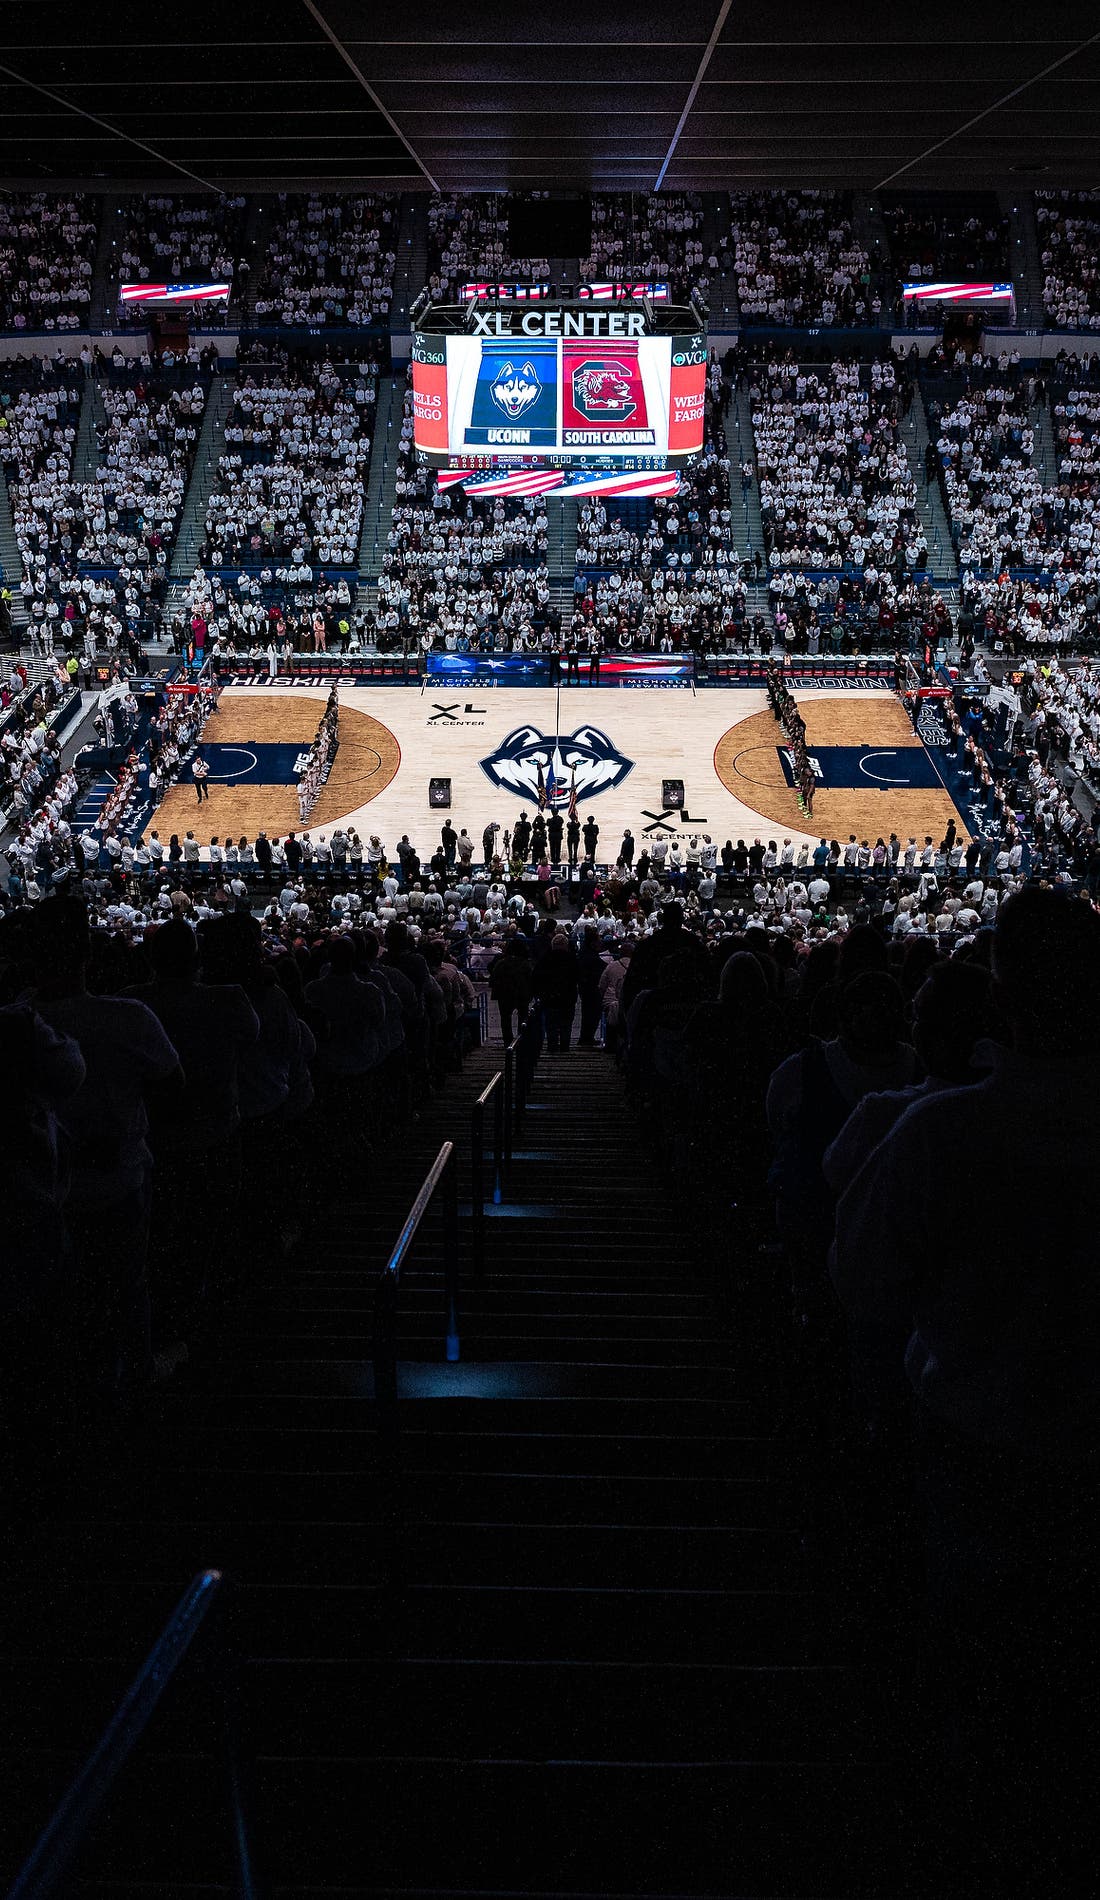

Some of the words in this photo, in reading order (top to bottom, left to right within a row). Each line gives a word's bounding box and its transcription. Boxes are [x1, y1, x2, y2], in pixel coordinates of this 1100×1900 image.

[472, 312, 512, 336] XL
[522, 312, 646, 336] CENTER
[415, 335, 426, 346] XL
[691, 336, 702, 348] XL
[414, 406, 442, 420] ARGO
[488, 430, 530, 444] UCONN
[566, 431, 600, 444] SOUTH
[602, 431, 654, 444] CAROLINA
[418, 452, 428, 462] XL
[686, 454, 698, 466] XL
[230, 677, 356, 686] HUSKIES
[428, 704, 487, 720] XL
[292, 752, 312, 773] BIG
[640, 810, 708, 832] XL
[705, 850, 717, 859] 34
